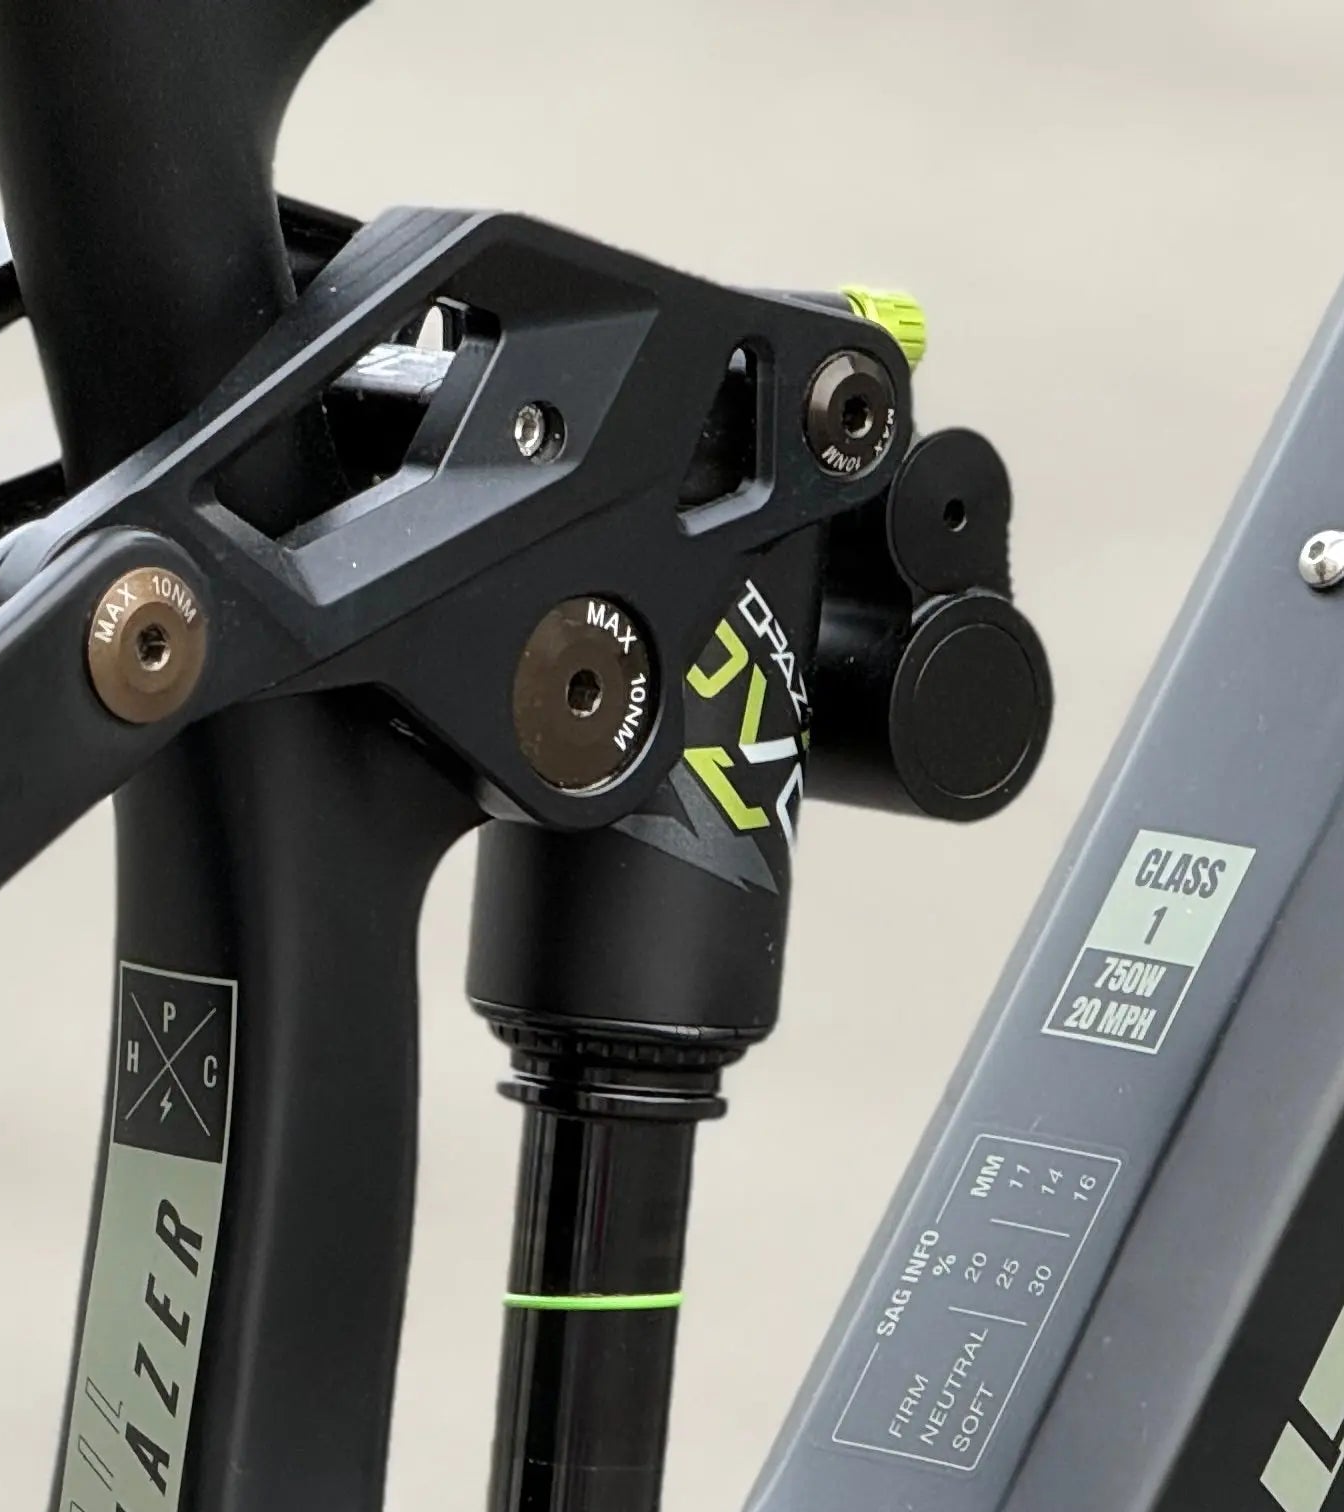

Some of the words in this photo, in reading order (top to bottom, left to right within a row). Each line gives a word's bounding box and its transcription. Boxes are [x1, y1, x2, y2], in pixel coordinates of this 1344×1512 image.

[821, 445, 861, 473] 10NM
[874, 408, 895, 457] MAX
[94, 582, 138, 643] MAX
[151, 575, 198, 624] 10NM
[586, 601, 637, 655] MAX
[614, 672, 647, 752] 10NM
[738, 578, 808, 724] OPAZ
[1135, 847, 1227, 899] CLASS
[1143, 906, 1168, 945] 1
[1094, 956, 1167, 998] 750W
[1063, 995, 1102, 1031] 20
[1096, 1000, 1157, 1041] MPH
[970, 1154, 1005, 1199] MM
[876, 1287, 912, 1338] SAG
[901, 1229, 940, 1284] INFO
[888, 1373, 929, 1439] FIRM
[964, 1251, 988, 1284] 20
[1008, 1163, 1031, 1190] 11
[919, 1327, 989, 1445] NEUTRAL
[996, 1257, 1020, 1290] 25
[1041, 1167, 1064, 1196] 14
[951, 1381, 994, 1452] SOFT
[1028, 1265, 1053, 1297] 30
[1073, 1173, 1097, 1202] 16
